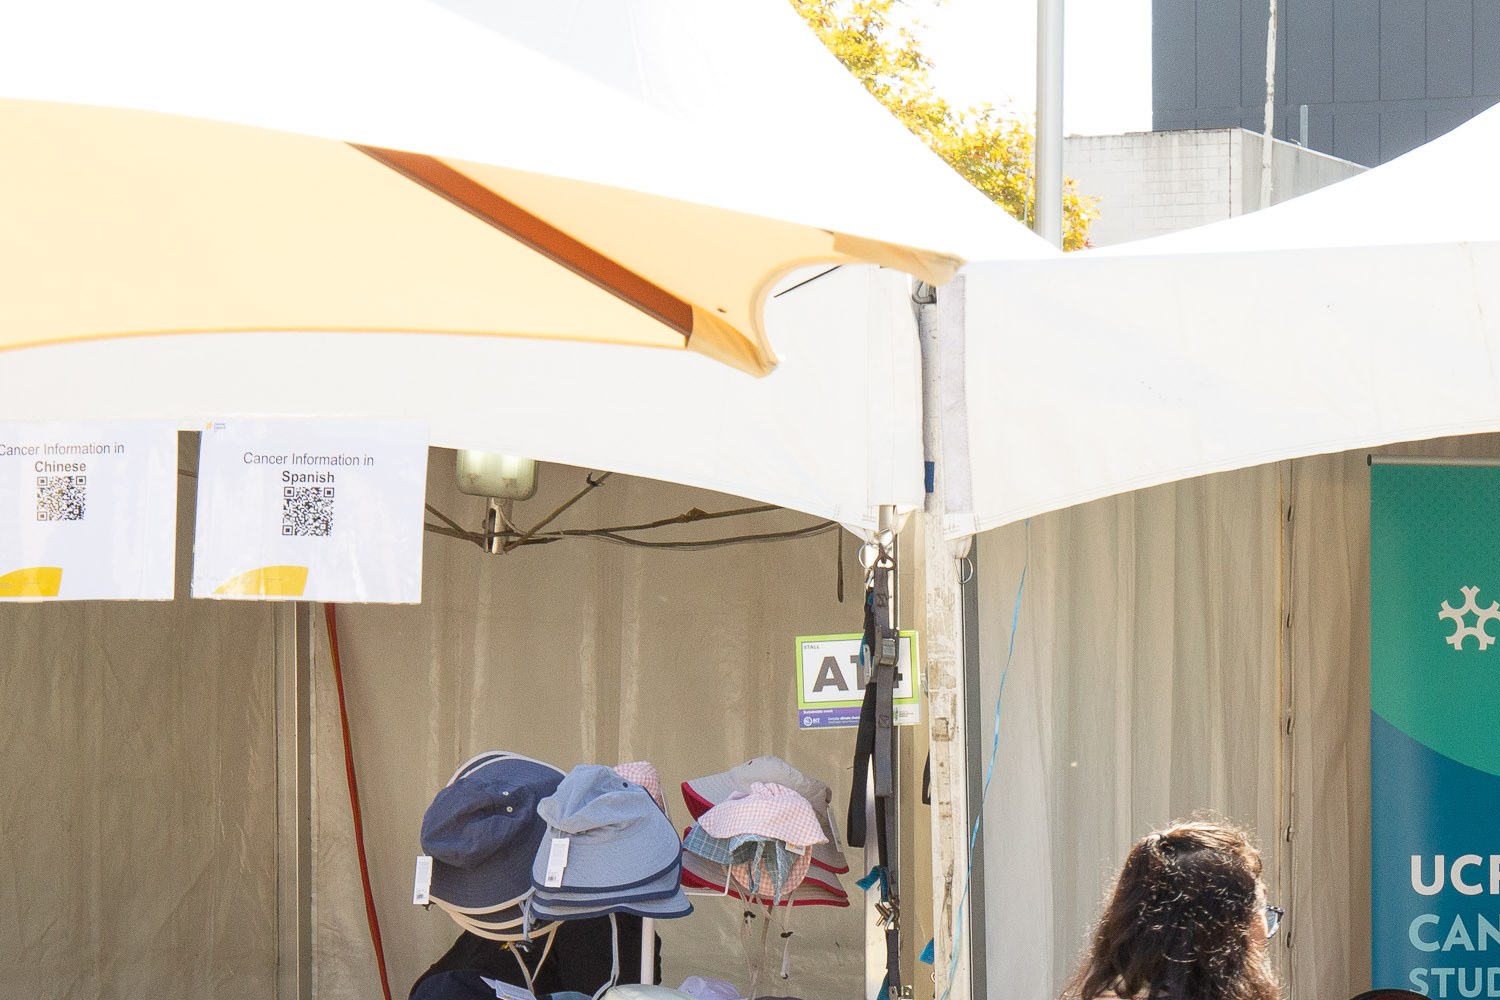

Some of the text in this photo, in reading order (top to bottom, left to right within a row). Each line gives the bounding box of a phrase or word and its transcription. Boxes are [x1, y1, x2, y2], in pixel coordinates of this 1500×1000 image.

[0, 442, 125, 456] Cancer Information in
[34, 460, 87, 473] Chinese
[243, 452, 375, 467] Cancer Information in
[281, 470, 336, 485] Spanish
